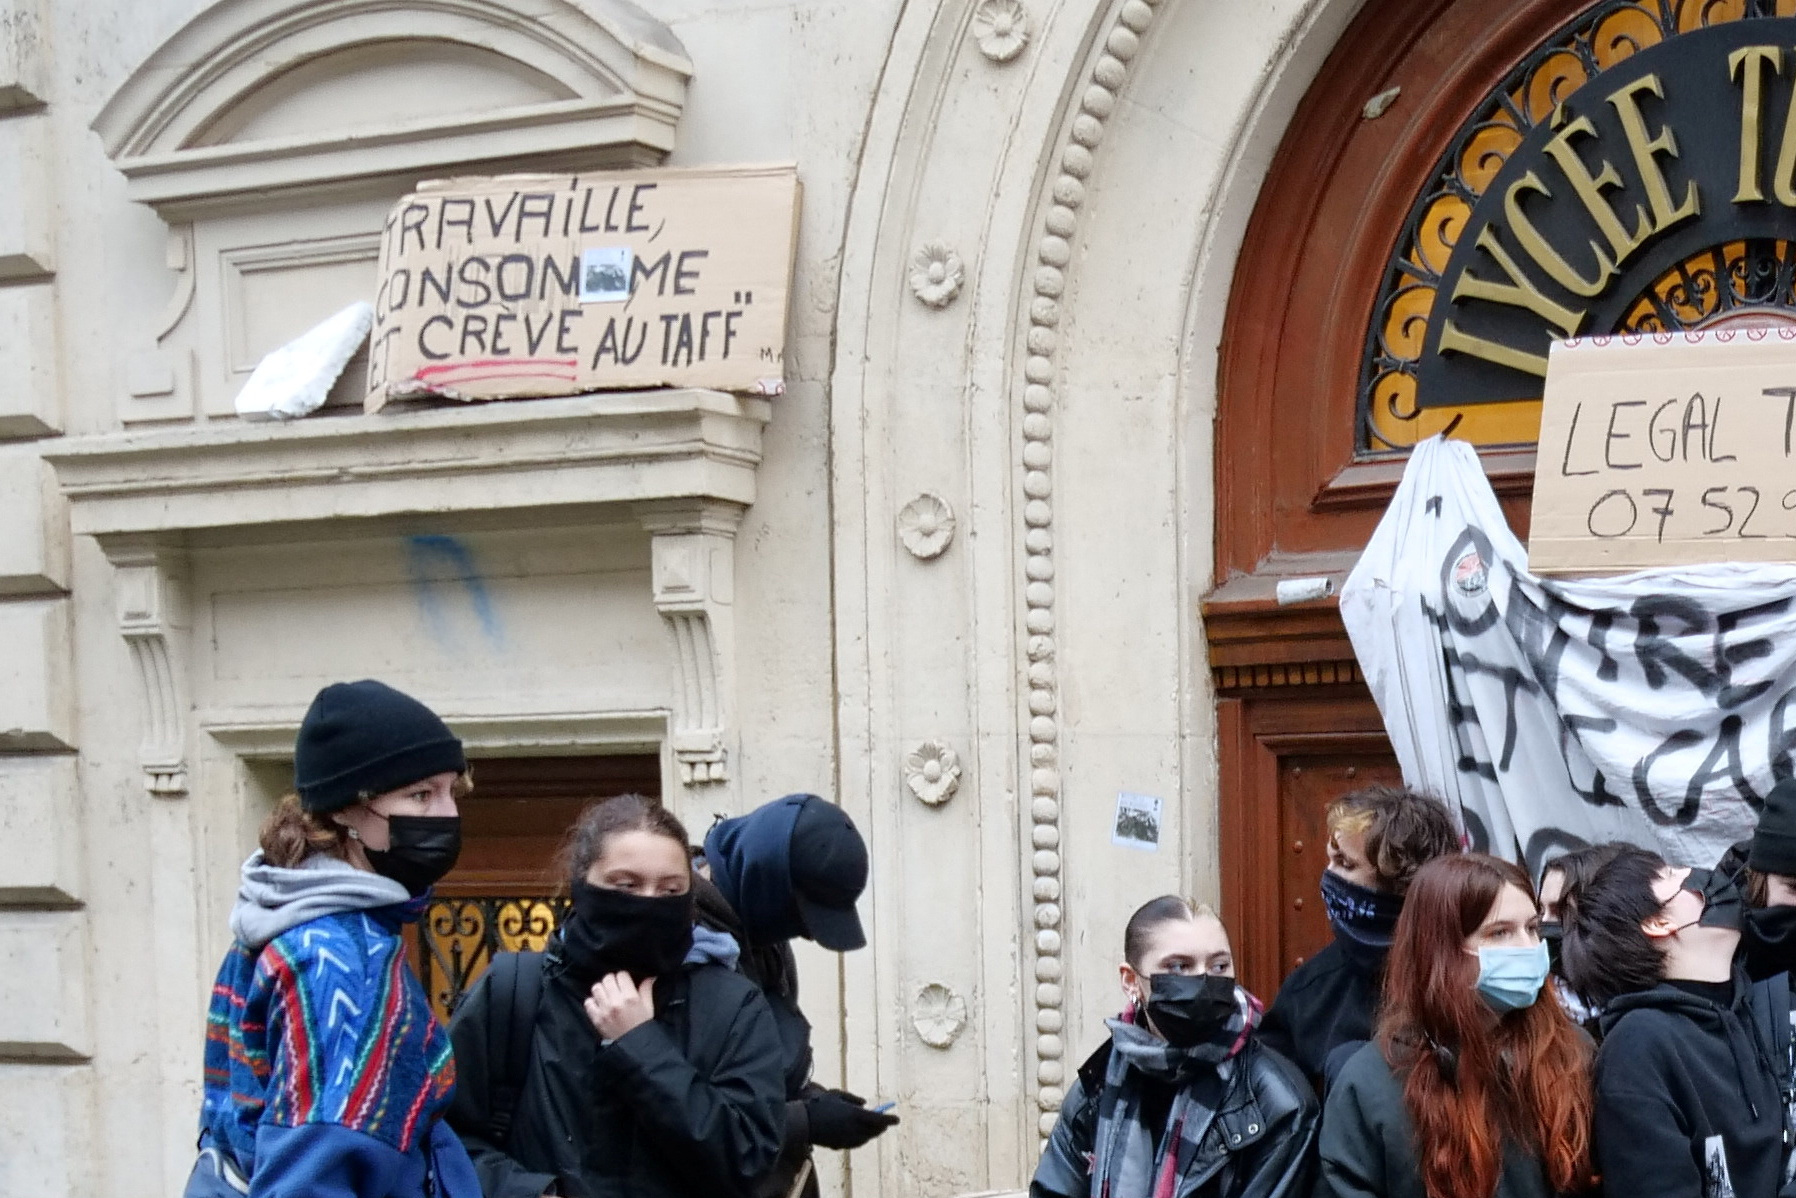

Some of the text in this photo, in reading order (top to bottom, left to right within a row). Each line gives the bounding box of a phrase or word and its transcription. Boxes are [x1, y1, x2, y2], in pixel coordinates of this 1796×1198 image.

[591, 315, 648, 371] AU
[1562, 391, 1737, 476] LEGAL
[1588, 488, 1675, 544] 07
[1701, 486, 1767, 538] 52
